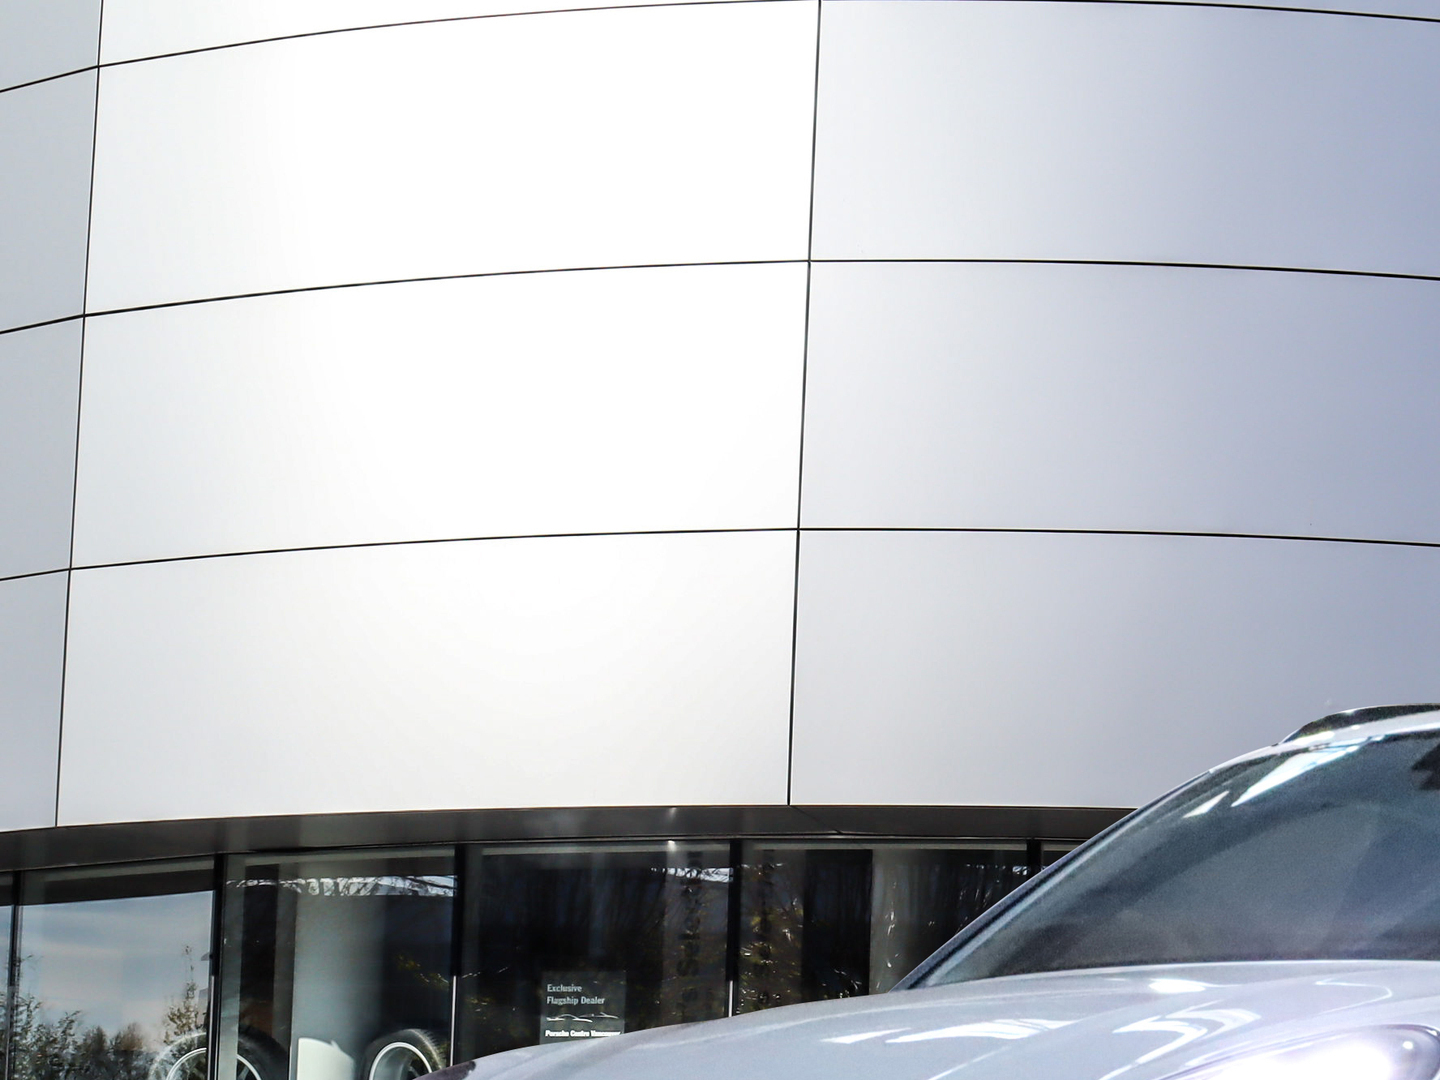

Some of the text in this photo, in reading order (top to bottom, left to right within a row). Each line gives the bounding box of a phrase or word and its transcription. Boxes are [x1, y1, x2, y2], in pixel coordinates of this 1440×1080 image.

[546, 984, 582, 992] Exclusive
[546, 996, 606, 1006] Flagship Dealer
